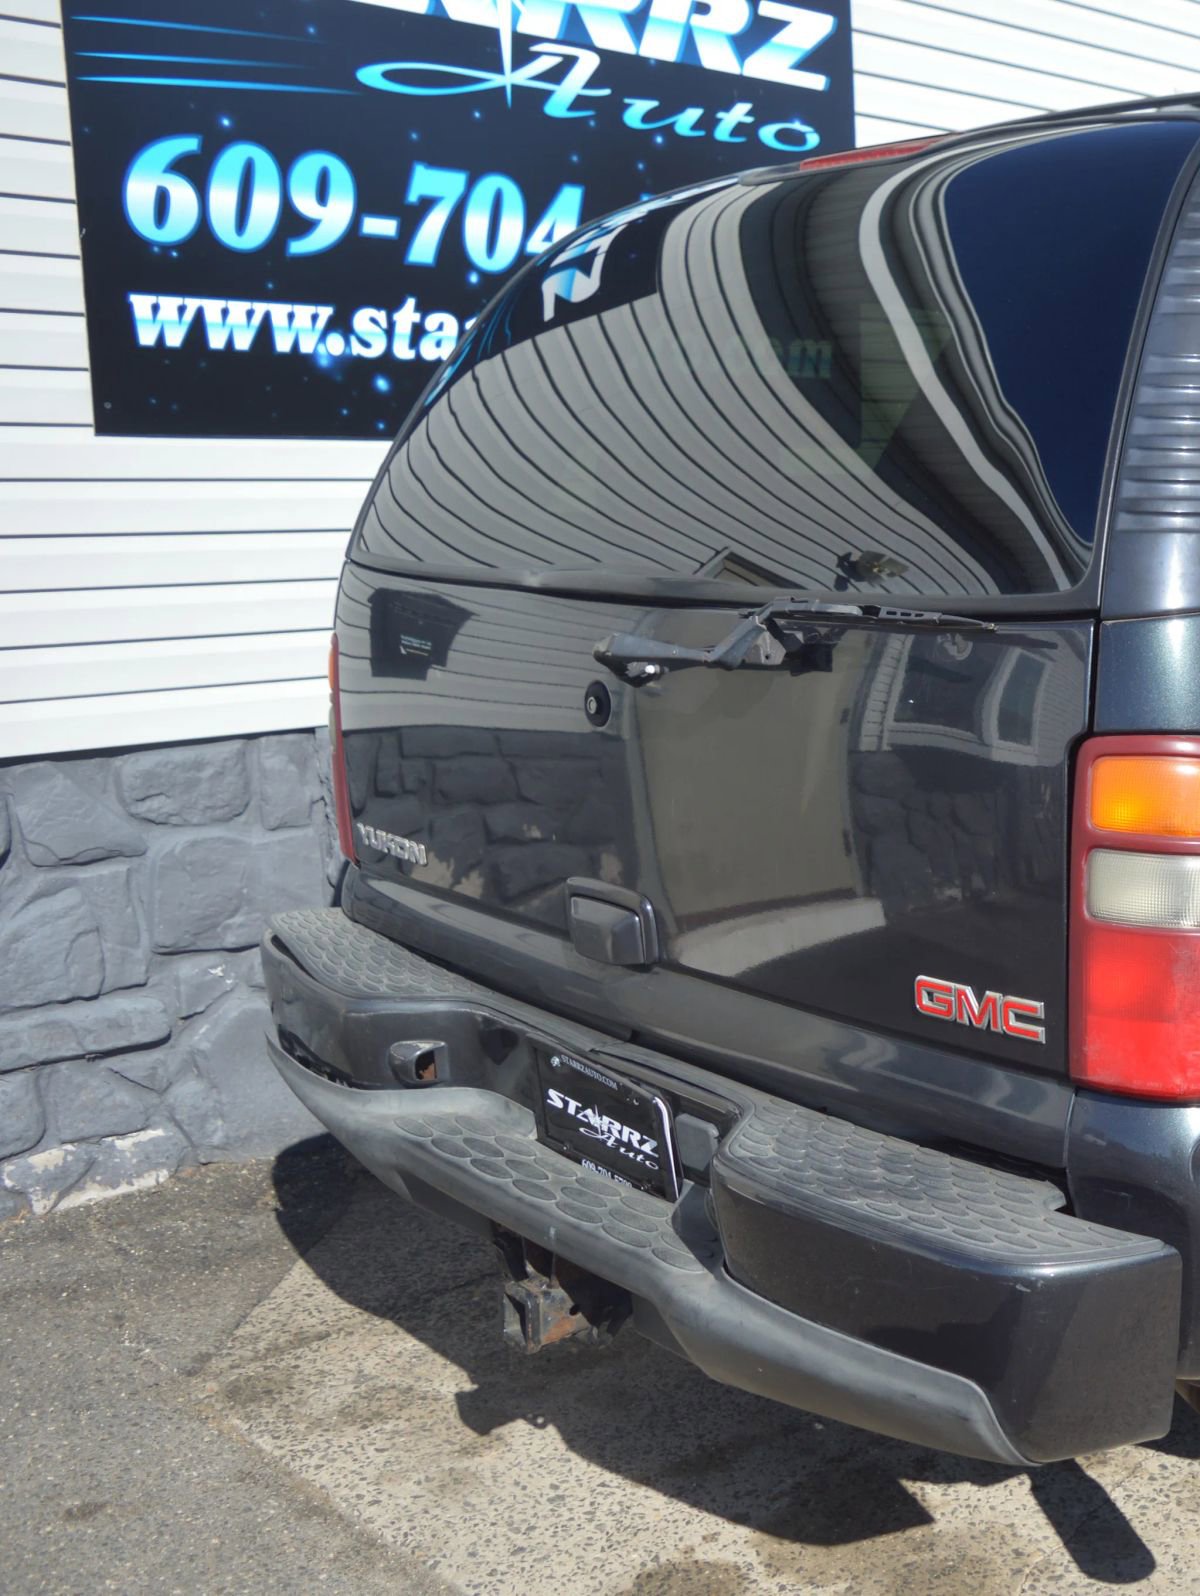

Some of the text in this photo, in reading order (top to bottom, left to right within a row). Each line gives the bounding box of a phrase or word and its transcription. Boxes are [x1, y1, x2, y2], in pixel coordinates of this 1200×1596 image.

[355, 42, 822, 153] Auto
[123, 134, 650, 274] 609-704
[129, 293, 477, 361] www.sta
[356, 822, 428, 866] YUKON
[914, 974, 1046, 1044] GMC
[546, 1088, 660, 1158] STARRZ
[579, 1128, 660, 1170] Auto
